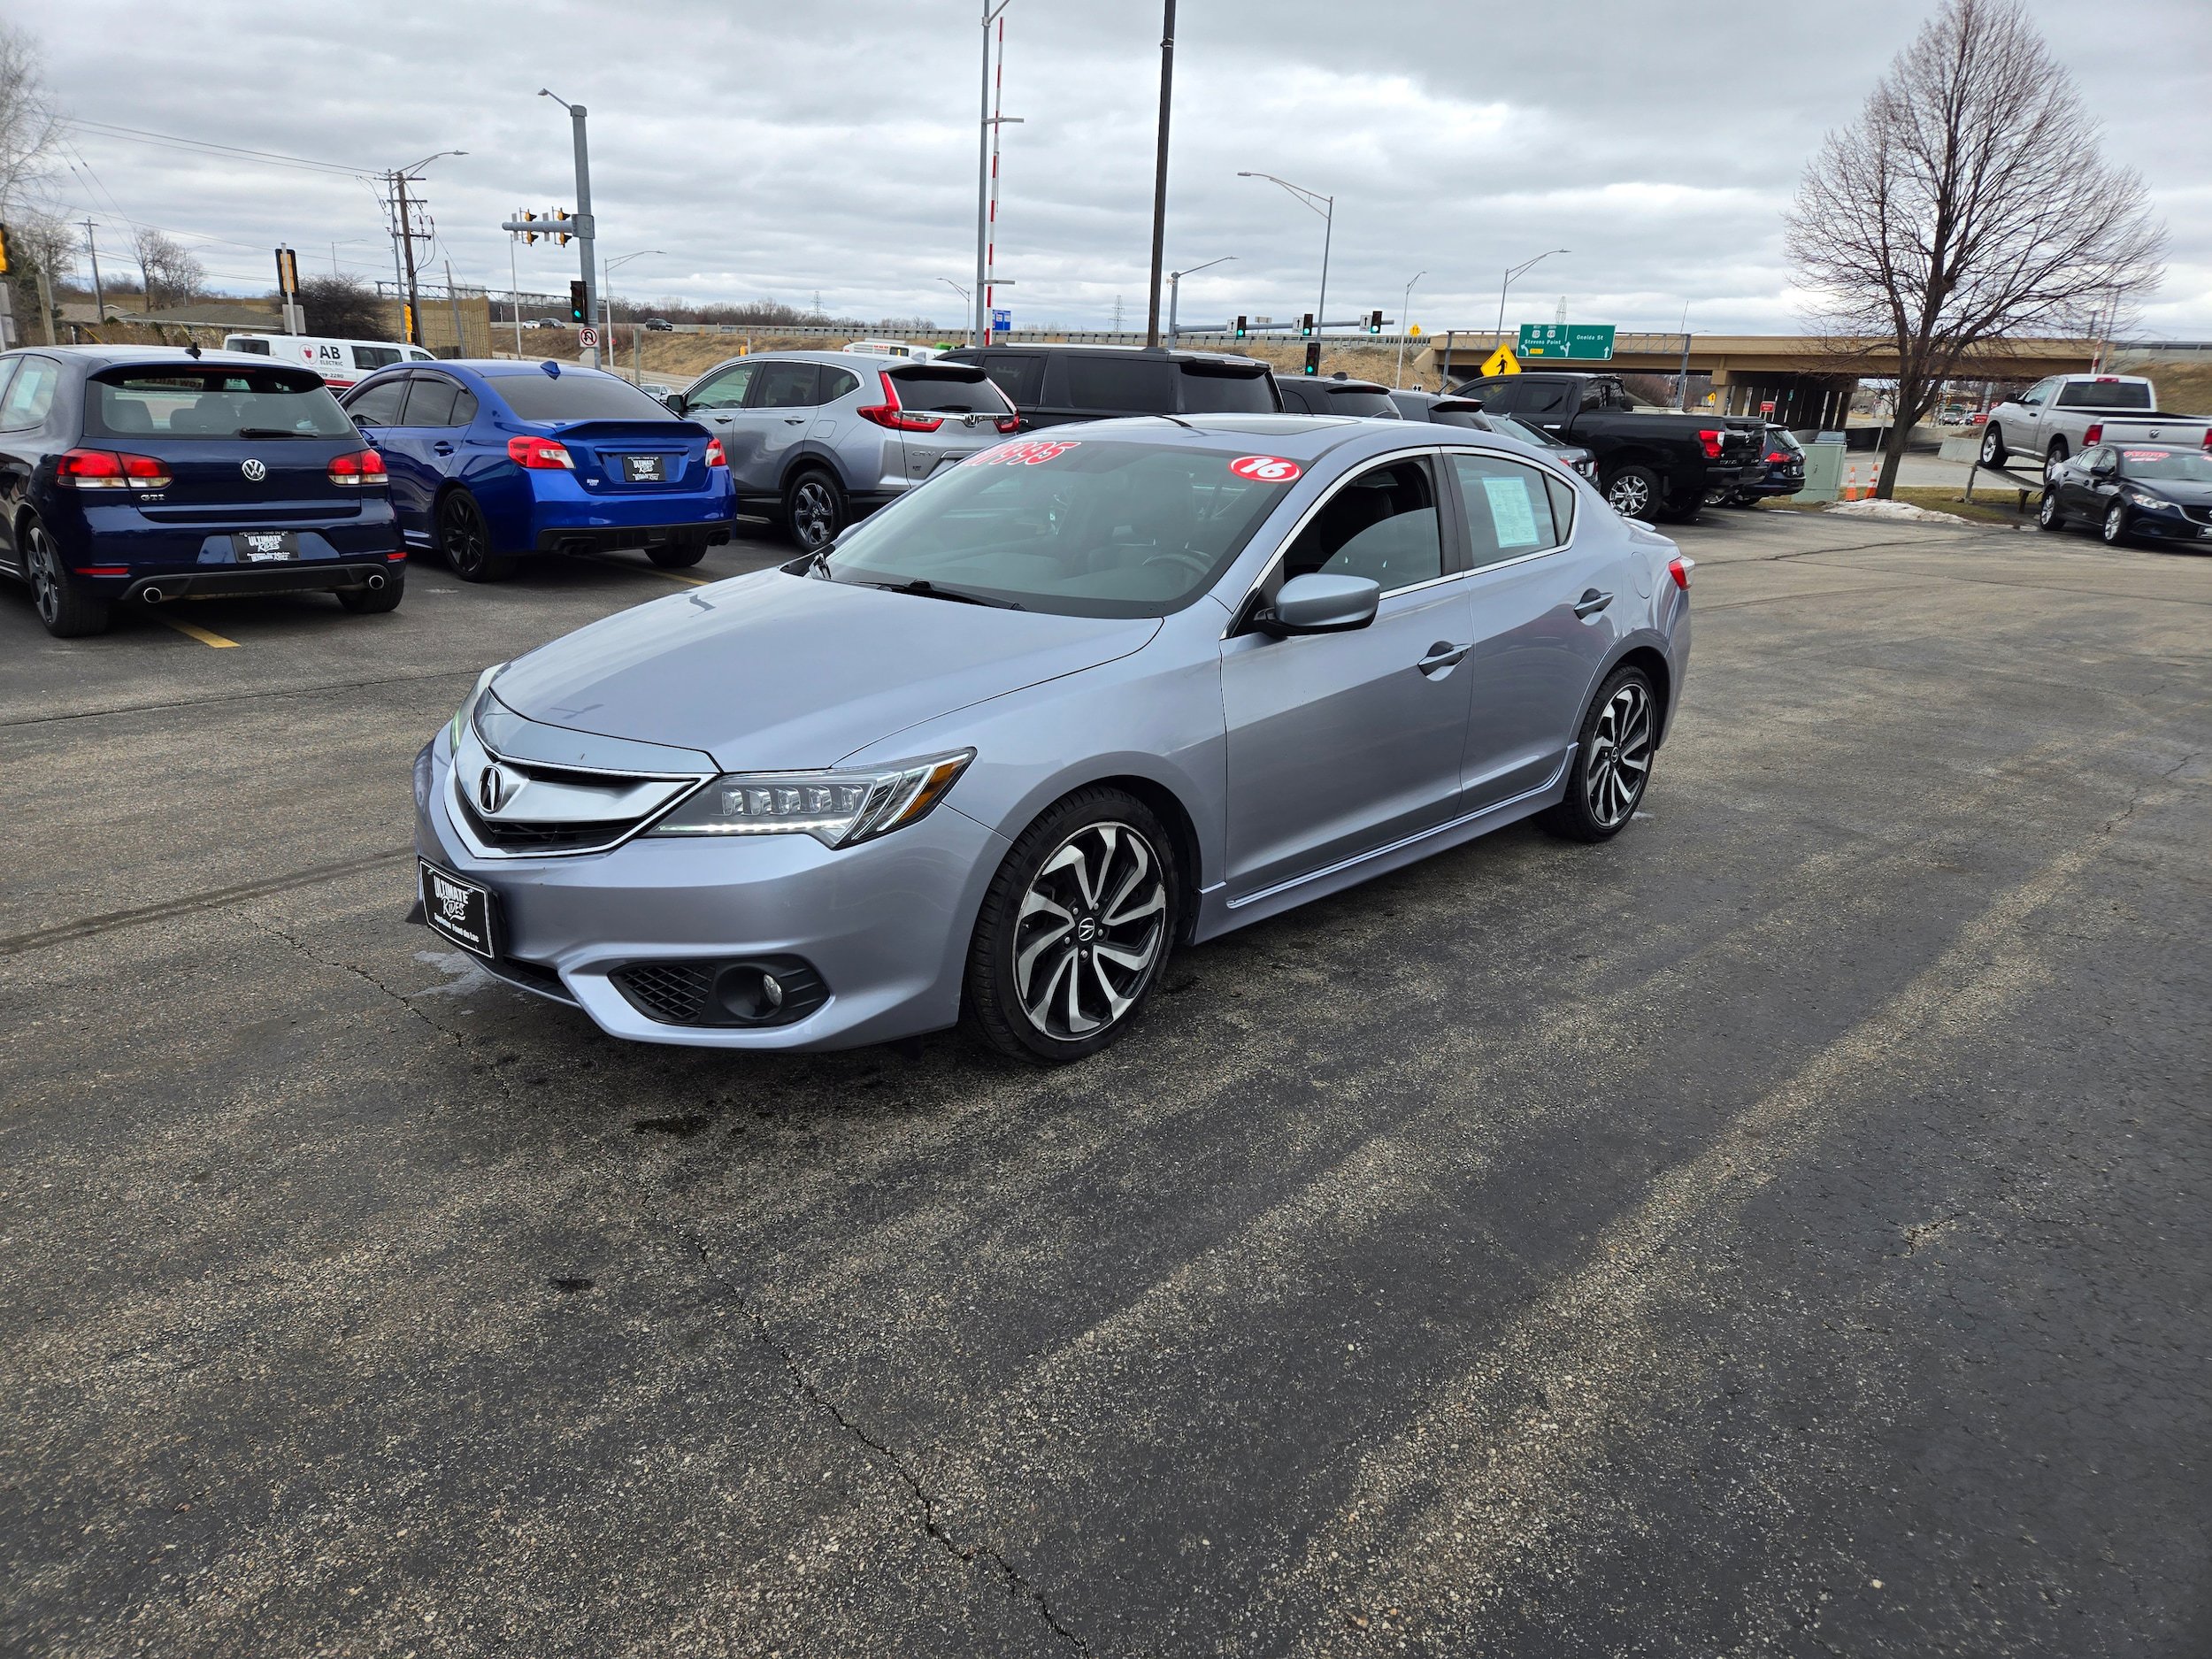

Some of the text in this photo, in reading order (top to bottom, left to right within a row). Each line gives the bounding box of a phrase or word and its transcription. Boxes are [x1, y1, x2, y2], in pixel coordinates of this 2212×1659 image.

[319, 345, 341, 359] AB
[1240, 458, 1292, 478] 16
[248, 534, 283, 547] ULTIMATE
[257, 541, 280, 552] RIDES
[434, 875, 469, 905] ULTIMATE
[442, 895, 466, 920] RIDES
